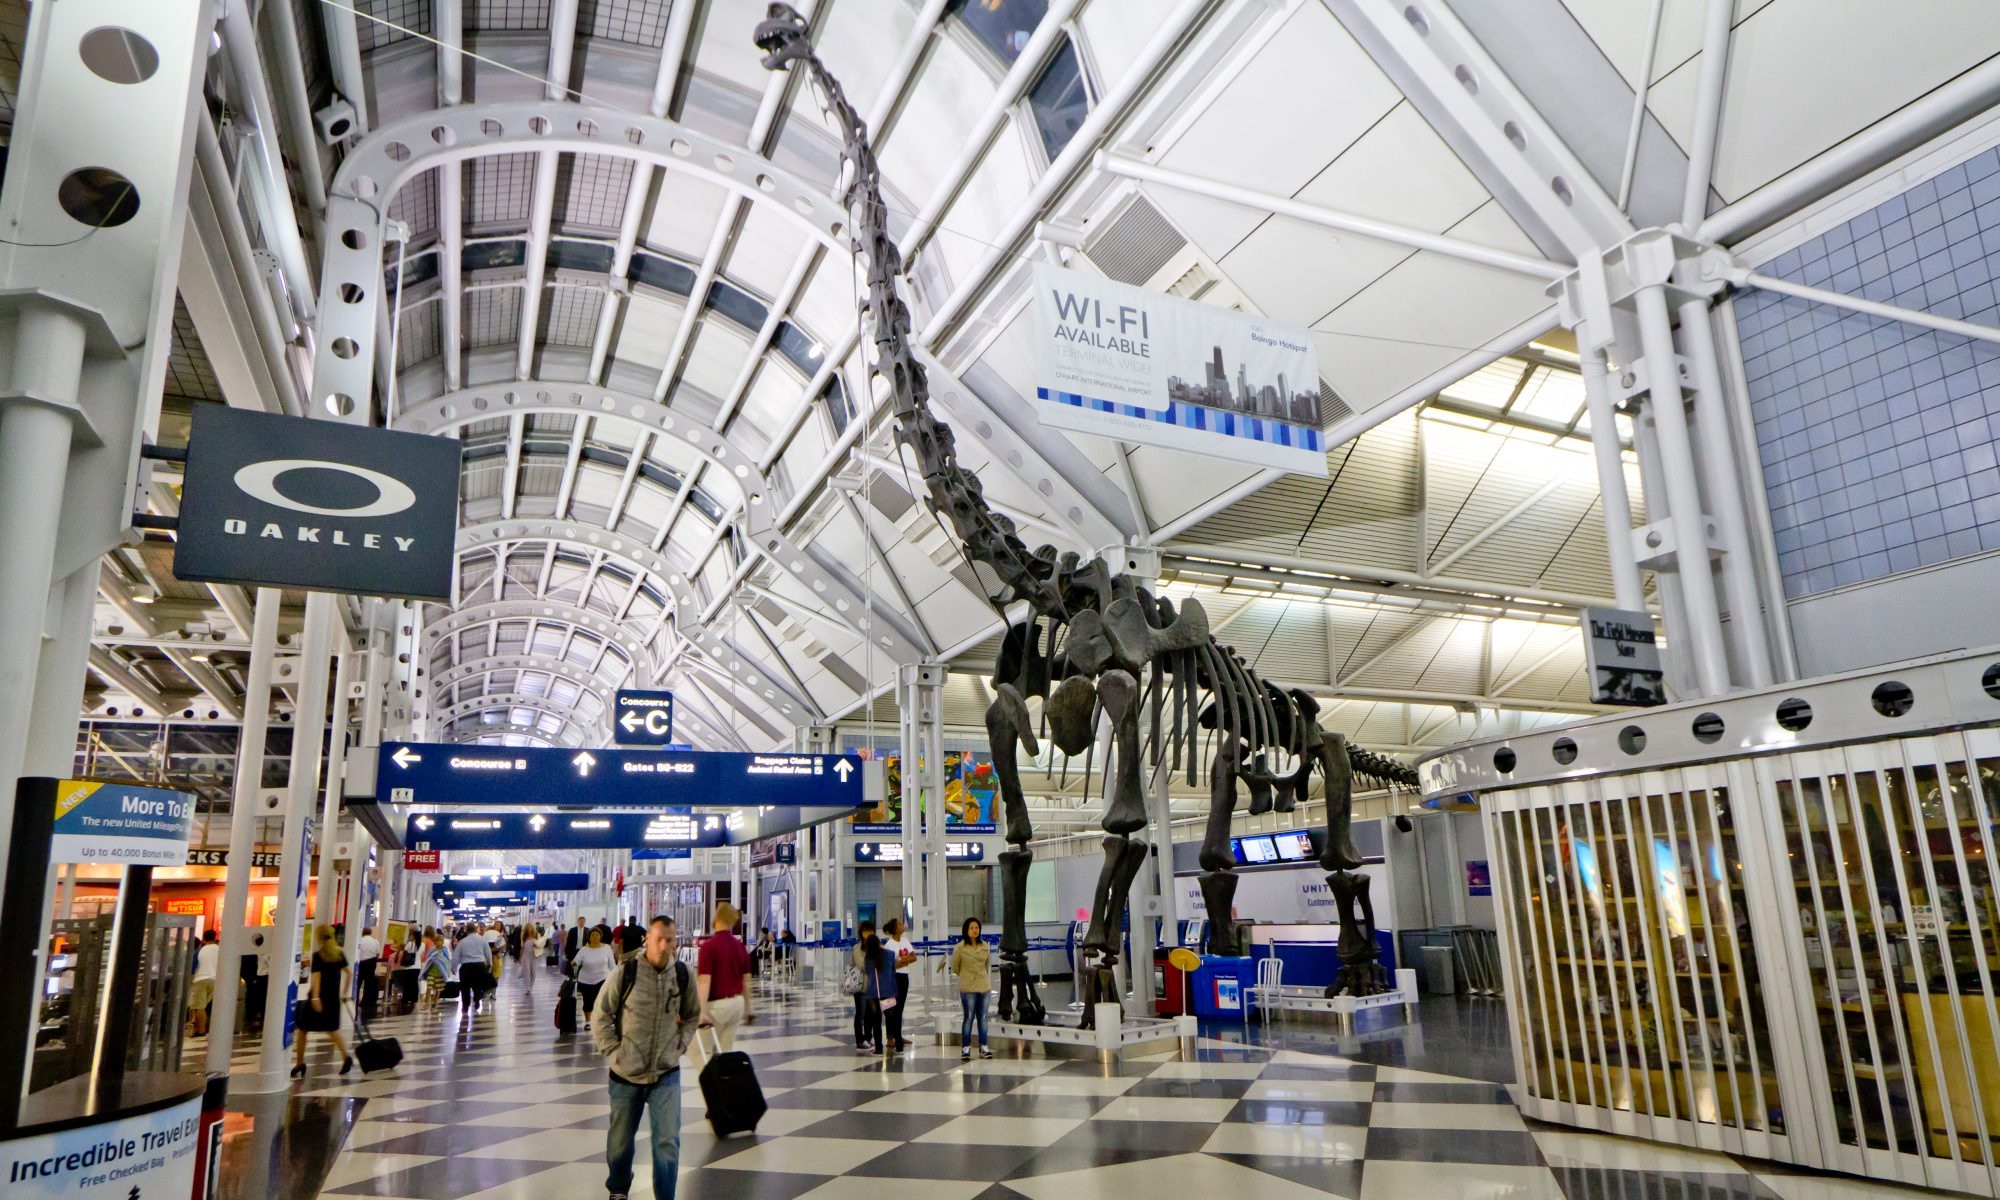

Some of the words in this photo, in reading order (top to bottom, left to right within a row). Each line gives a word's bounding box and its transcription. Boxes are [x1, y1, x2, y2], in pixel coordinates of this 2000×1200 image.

[1052, 288, 1149, 339] WI-FI
[1053, 324, 1151, 358] AVAILABLE
[1251, 332, 1278, 346] Boingo
[1278, 339, 1308, 352] Hotspot
[1055, 344, 1116, 368] TERMINAL
[1080, 377, 1127, 392] INTERNATIONAL
[1127, 386, 1152, 396] AIRPORT
[223, 518, 416, 551] OAKLEY
[620, 696, 670, 707] Concourse
[645, 709, 669, 735] C
[450, 757, 512, 769] Concourse
[623, 762, 654, 772] Gates
[61, 785, 88, 809] NEW
[121, 795, 165, 816] More
[167, 800, 181, 818] To
[82, 816, 101, 826] The
[102, 818, 124, 828] new
[125, 819, 152, 829] United
[82, 847, 96, 858] Up
[99, 848, 108, 857] to
[408, 854, 436, 863] FREE
[1302, 884, 1329, 894] UNIT
[10, 1137, 136, 1183] Incredible
[141, 1120, 184, 1152] Travel
[79, 1174, 107, 1189] Free
[109, 1160, 150, 1179] Checked
[150, 1156, 166, 1168] Bag
